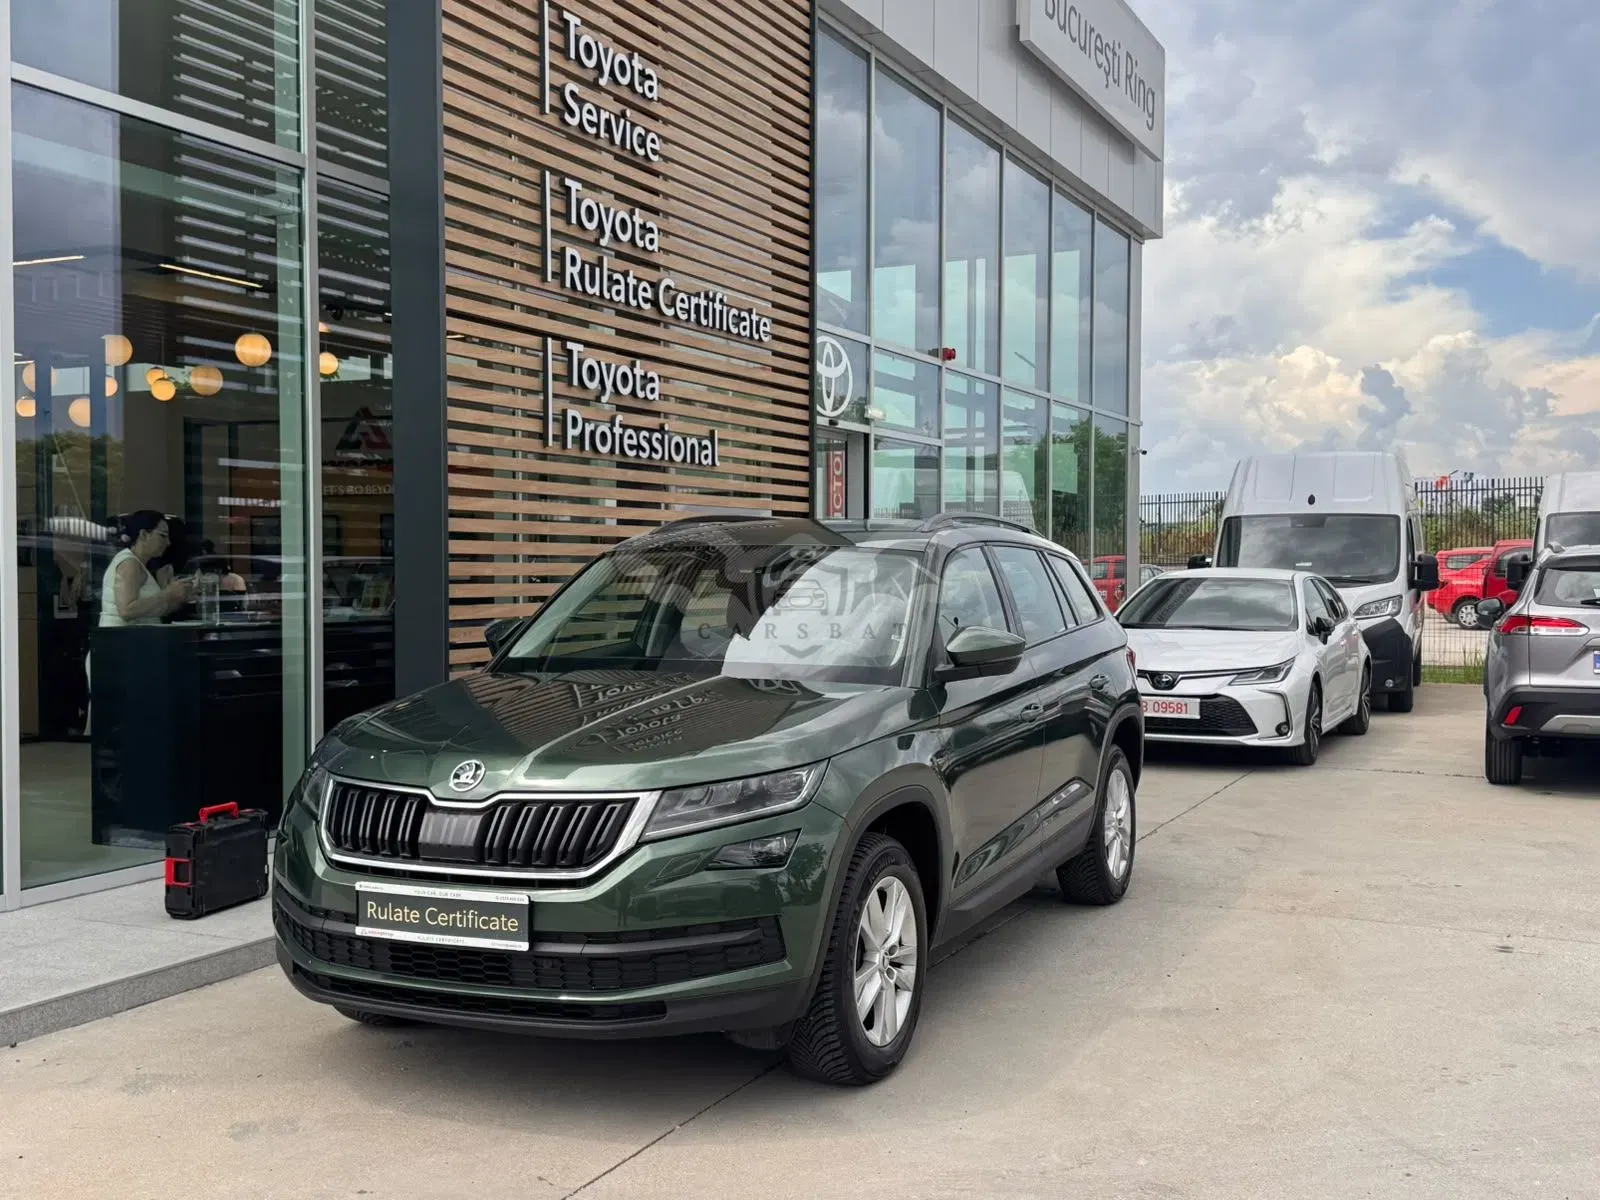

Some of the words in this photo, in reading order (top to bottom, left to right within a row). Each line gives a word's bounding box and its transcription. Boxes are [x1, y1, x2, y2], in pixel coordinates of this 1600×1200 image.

[562, 11, 659, 101] Toyota
[1125, 51, 1156, 131] Ring
[563, 83, 661, 162] Service
[564, 178, 660, 253] Toyota
[565, 246, 652, 311] Rulate
[658, 277, 771, 343] Certificate
[566, 341, 660, 403] Toyota
[566, 408, 720, 467] Professional
[1153, 701, 1188, 714] 09581
[367, 901, 420, 924] Rulate
[425, 907, 519, 932] Certificate
